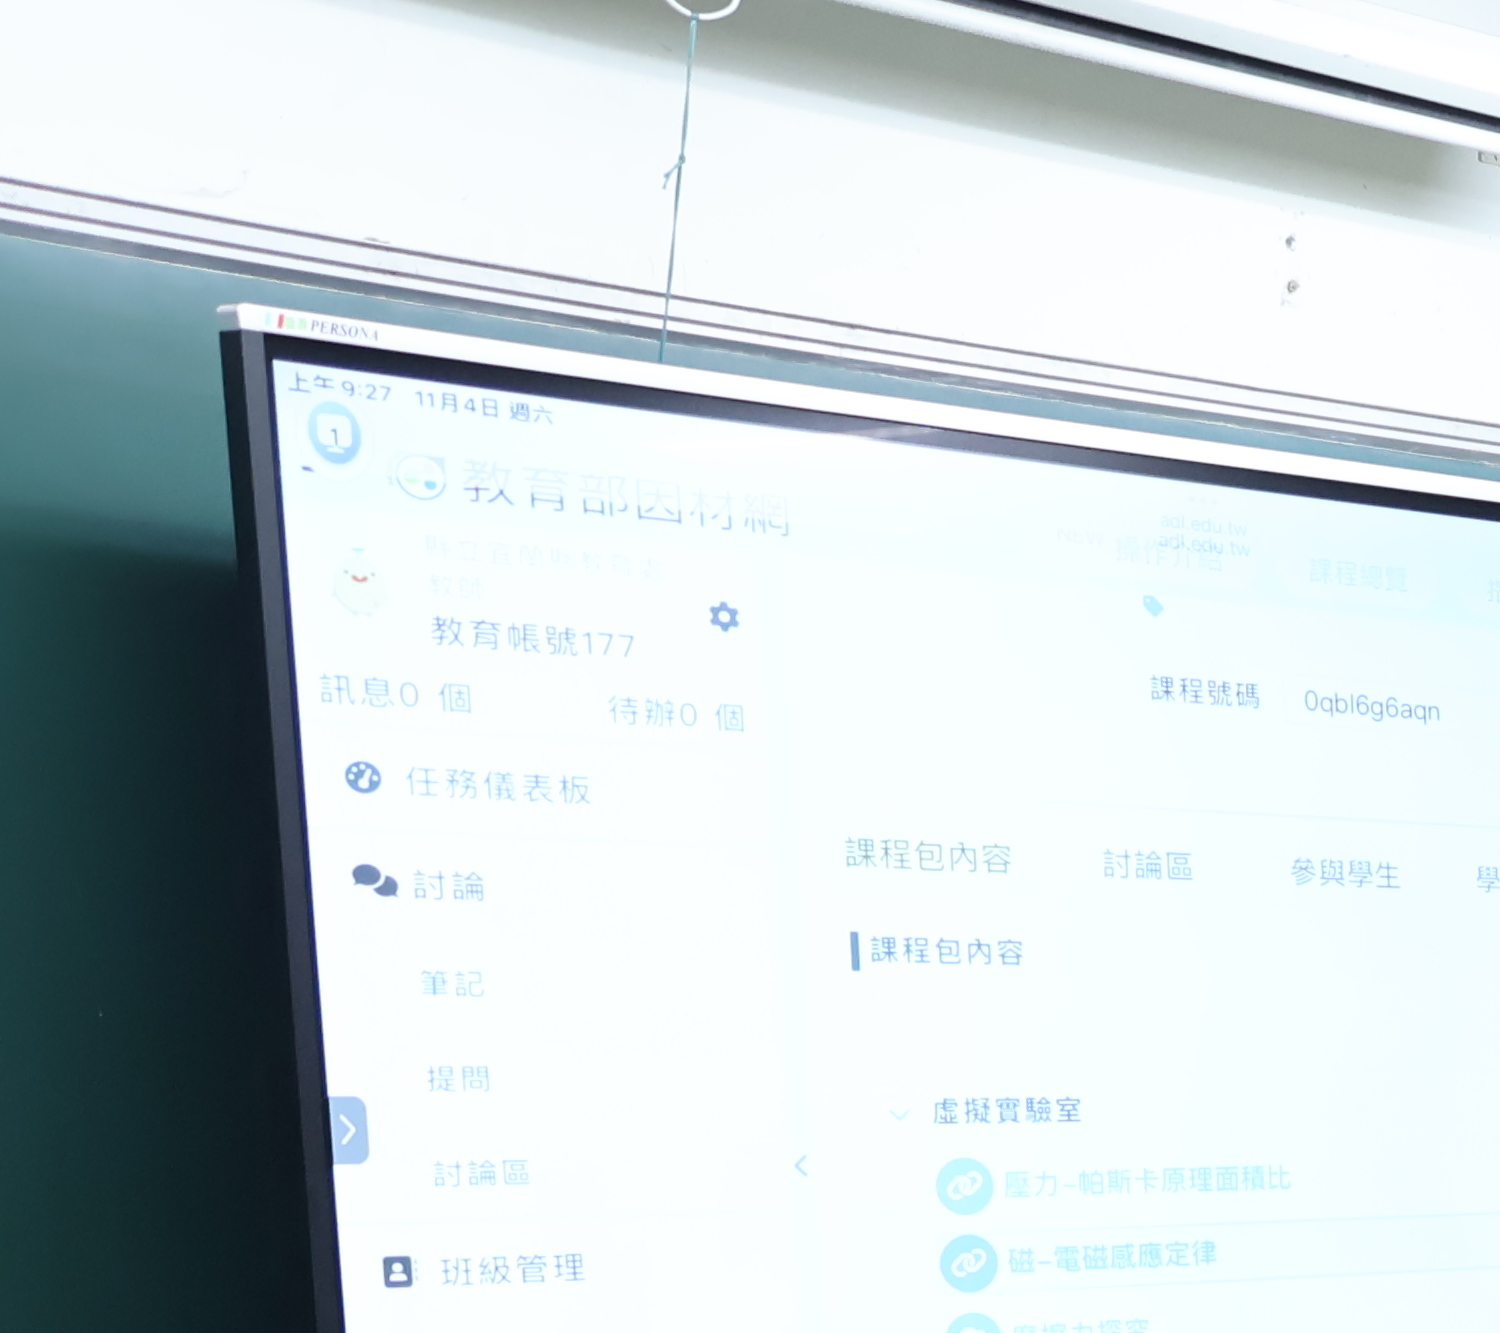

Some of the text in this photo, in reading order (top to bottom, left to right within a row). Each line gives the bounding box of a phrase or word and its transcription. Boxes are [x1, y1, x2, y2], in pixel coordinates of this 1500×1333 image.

[310, 319, 379, 342] PERSONA
[287, 371, 392, 402] 上午 9:27
[414, 391, 555, 426] 11月4日 週六
[430, 615, 635, 658] 教育帳號177
[319, 672, 472, 714] 訊息0 個
[1150, 674, 1260, 709] 課程號碼
[607, 695, 745, 733] 待辦0 個
[405, 766, 592, 805] 任務儀表板
[844, 836, 1013, 875] 課程包內容
[1102, 848, 1195, 882] 討論區
[412, 868, 486, 902] 討論
[1290, 857, 1401, 891] 參與學生
[869, 935, 1025, 967] 課程包內容
[420, 969, 486, 998] 筆記
[426, 1064, 491, 1093] 提問
[932, 1095, 1083, 1126] 虛擬實驗室
[433, 1158, 531, 1188] 討論區
[440, 1252, 586, 1287] 班級管理
